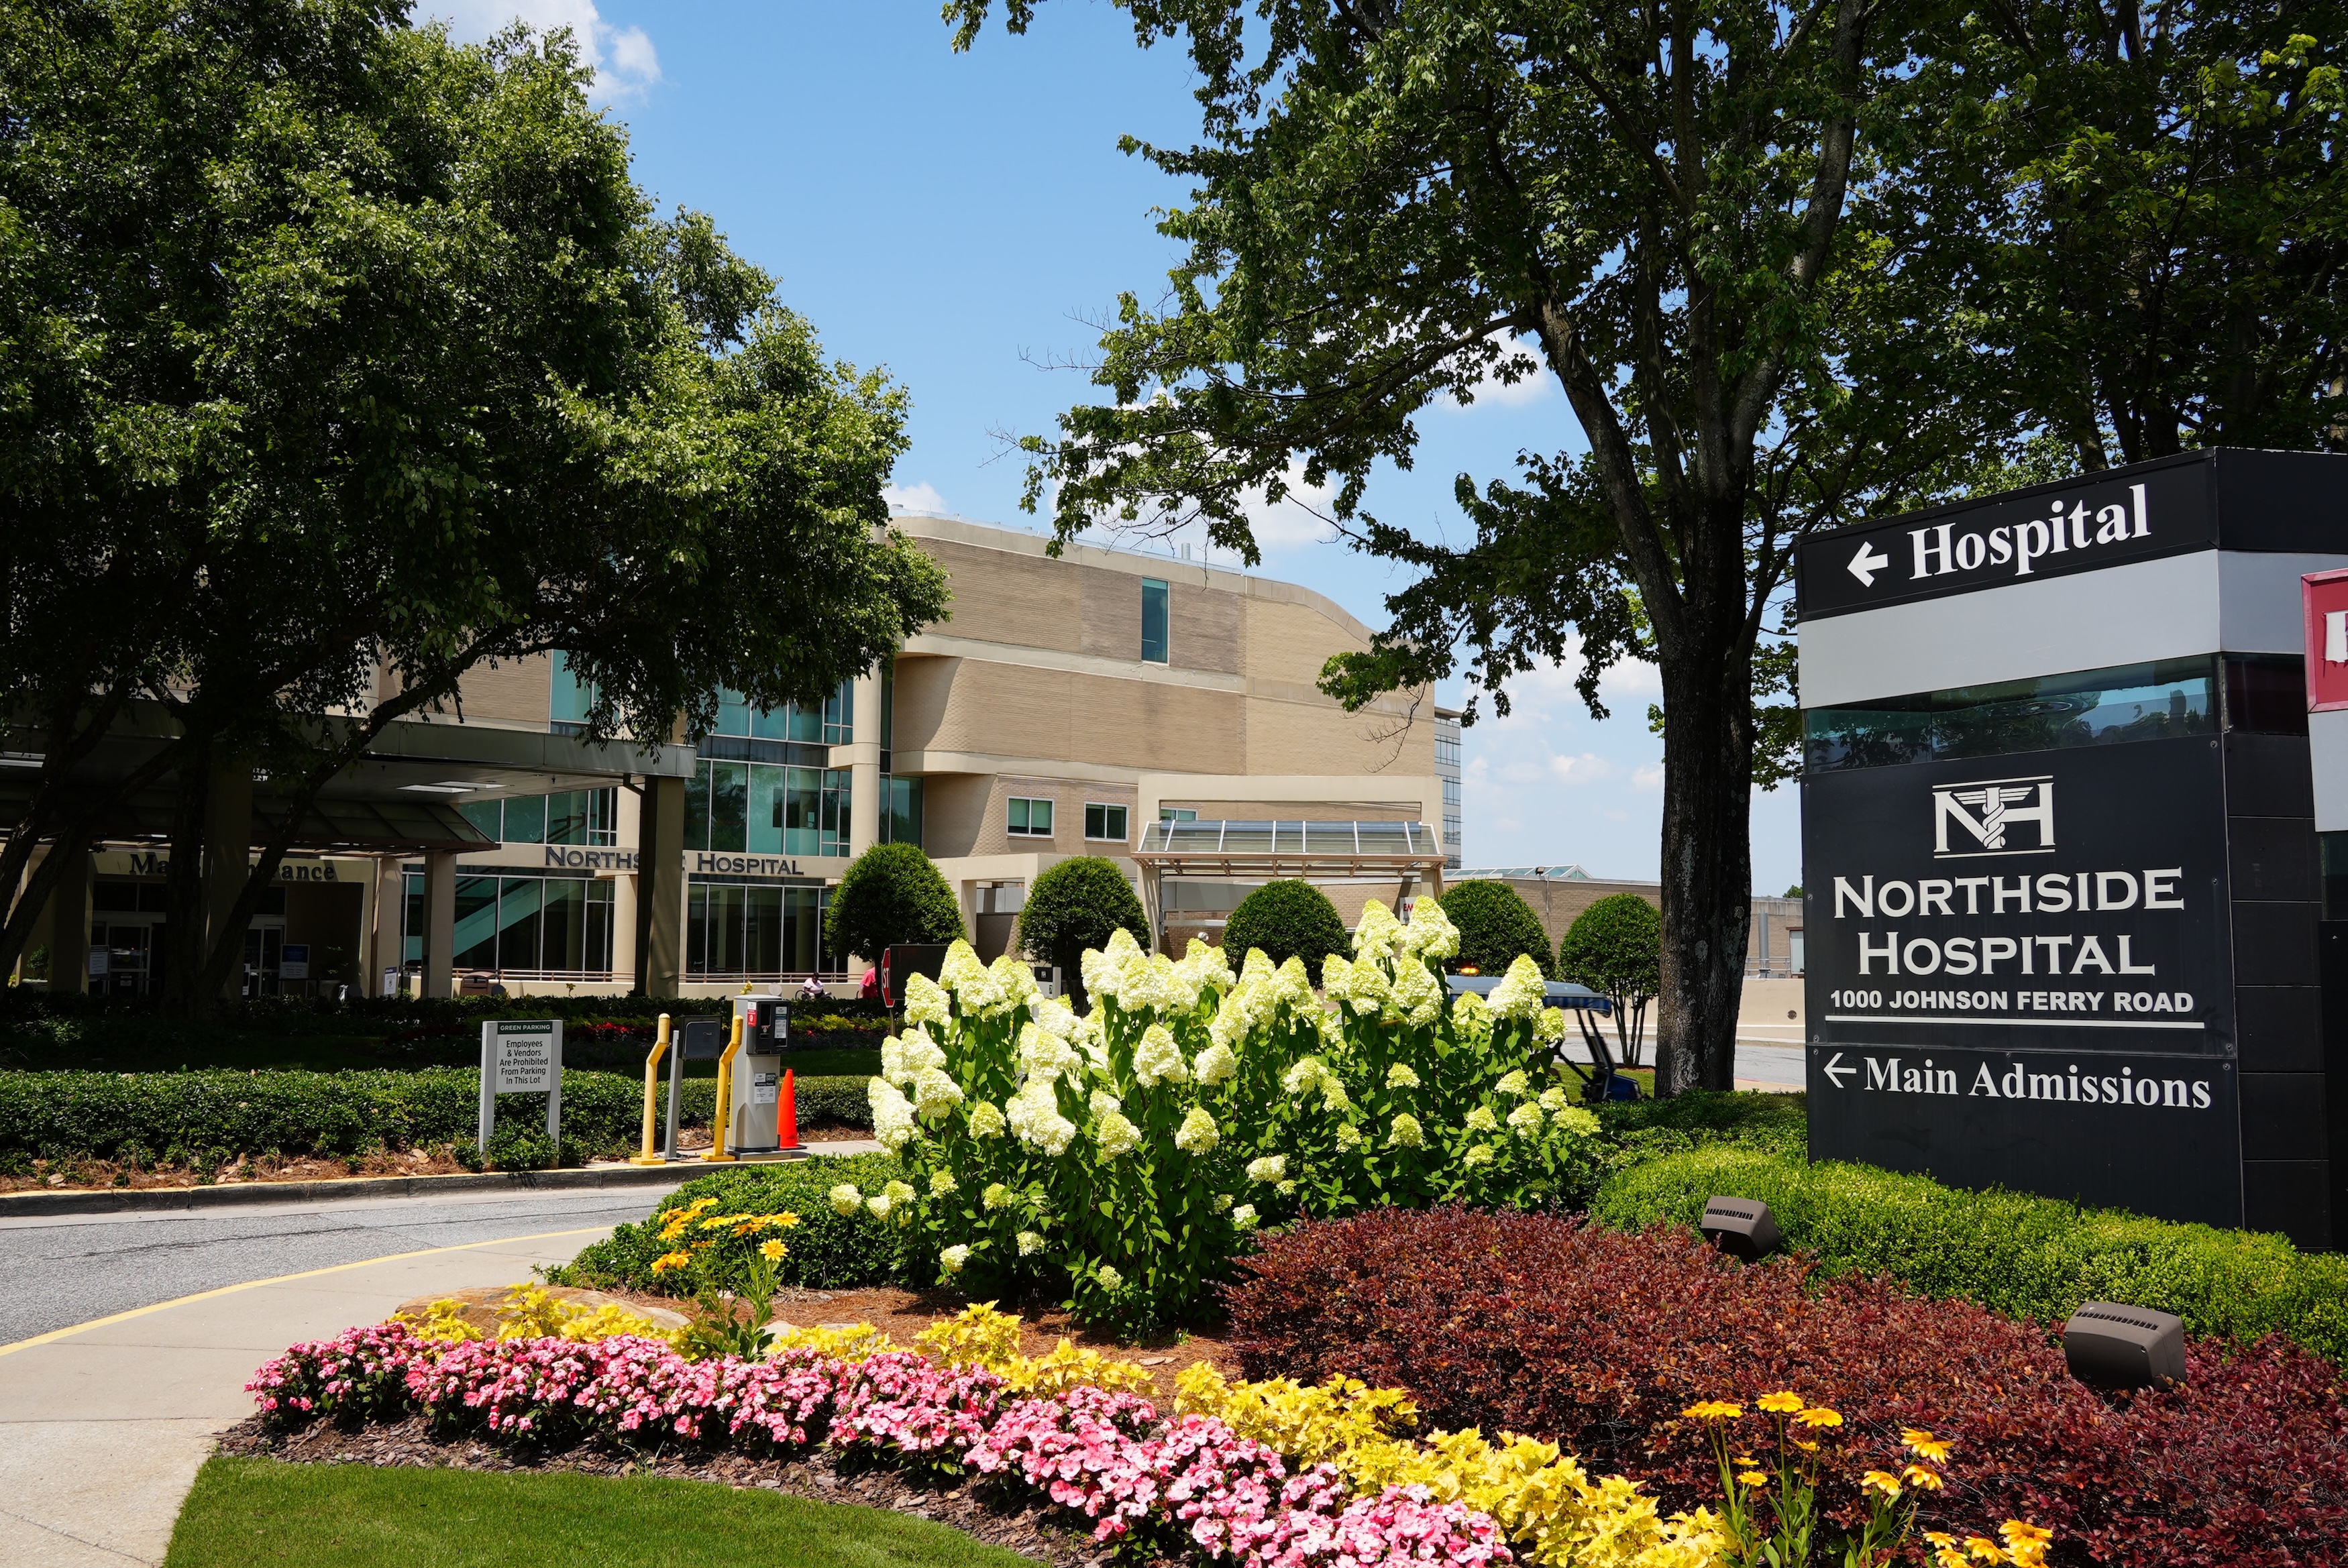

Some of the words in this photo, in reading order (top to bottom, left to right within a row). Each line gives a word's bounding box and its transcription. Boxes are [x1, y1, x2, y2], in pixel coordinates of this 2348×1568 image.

[1907, 483, 2151, 580] Hospital
[129, 853, 170, 873] Ma
[697, 852, 804, 875] HOSPITAL
[1833, 866, 2184, 919] NORTHSIDE
[1858, 932, 2155, 976] HOSPITAL
[1830, 990, 1882, 1009] 1000
[1888, 990, 2008, 1010] JOHNSON
[2017, 991, 2104, 1011] FERRY
[2114, 992, 2194, 1013] ROAD
[506, 1040, 543, 1049] Employees
[506, 1049, 512, 1057] &
[514, 1049, 541, 1057] Vendors
[513, 1057, 548, 1066] Prohibited
[520, 1066, 546, 1076] Parking
[506, 1076, 513, 1084] In
[514, 1076, 528, 1084] This
[529, 1075, 541, 1084] Lot
[1863, 1057, 1959, 1095] Main
[1968, 1061, 2211, 1109] Admissions
